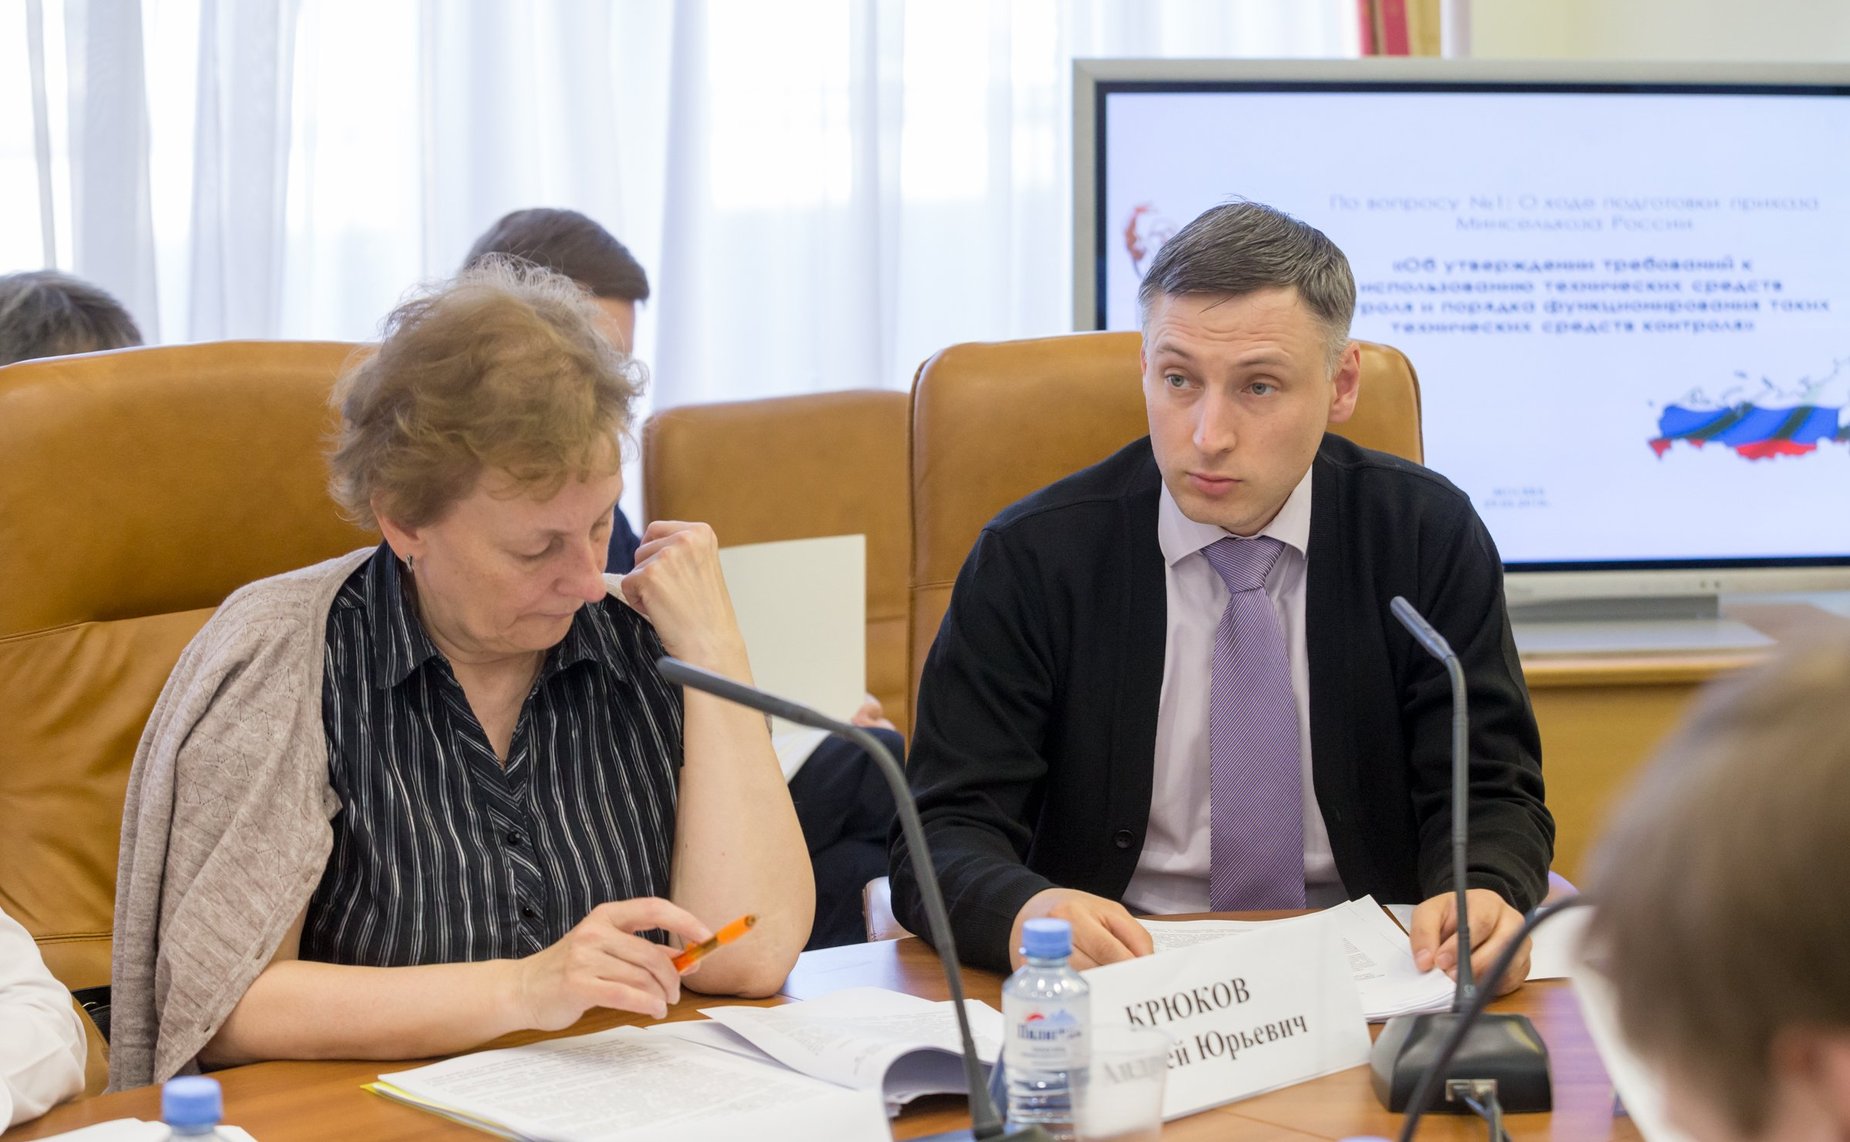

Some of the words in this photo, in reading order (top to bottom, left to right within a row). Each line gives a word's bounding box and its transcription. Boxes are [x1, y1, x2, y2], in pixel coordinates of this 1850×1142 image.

[1367, 196, 1458, 211] вопросу
[1603, 197, 1720, 211] подготовки
[1730, 197, 1819, 212] приказа
[1456, 216, 1602, 231] Минсельхоза
[1611, 215, 1694, 231] России
[1444, 259, 1594, 274] утверждении
[1604, 256, 1734, 273] требований
[1359, 281, 1534, 294] использованию
[1544, 280, 1681, 293] технических
[1691, 281, 1783, 294] средств
[1441, 302, 1535, 316] порядка
[1543, 301, 1760, 315] функционирования
[1770, 302, 1829, 313] таких
[1391, 321, 1531, 334] технических
[1541, 322, 1634, 335] средств
[1124, 976, 1251, 1031] КРЮКОВ
[1195, 1014, 1309, 1061] Юрьевич
